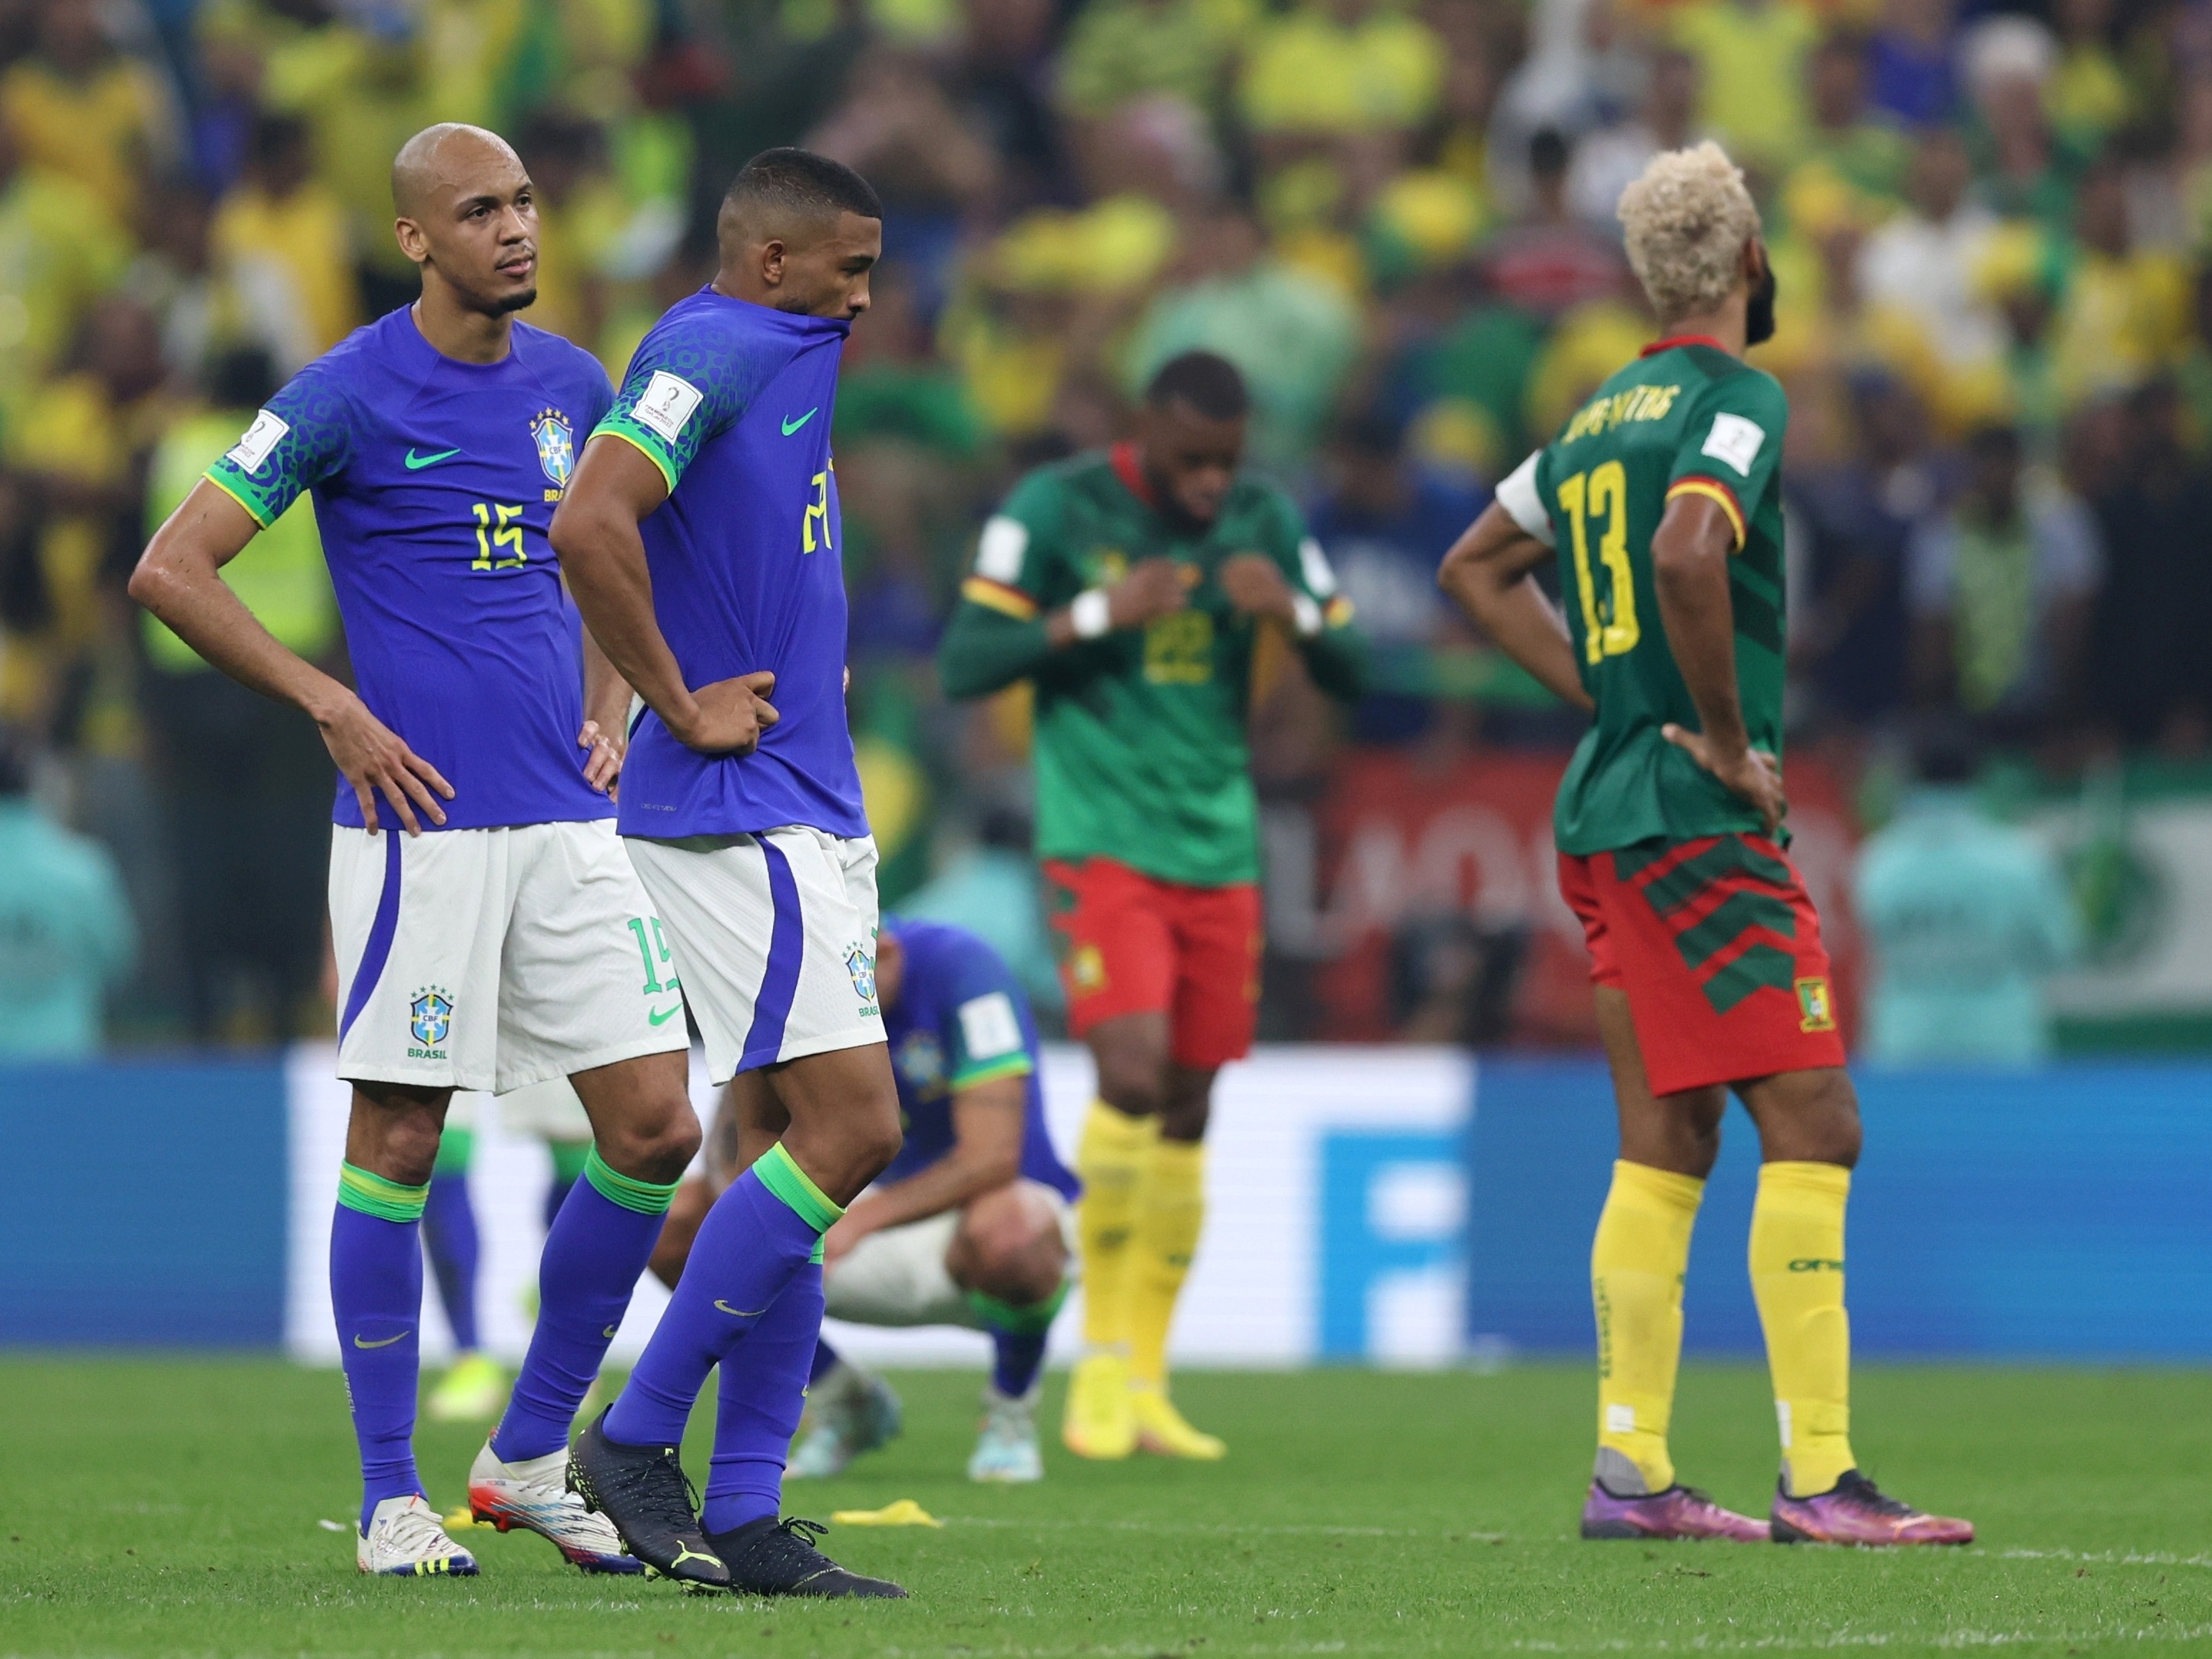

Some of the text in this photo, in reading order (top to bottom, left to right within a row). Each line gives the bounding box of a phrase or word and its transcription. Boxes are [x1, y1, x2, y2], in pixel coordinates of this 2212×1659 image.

[549, 446, 562, 455] CBF
[472, 503, 528, 571] 15
[1557, 459, 1640, 665] 13
[407, 1047, 447, 1060] BRASIL
